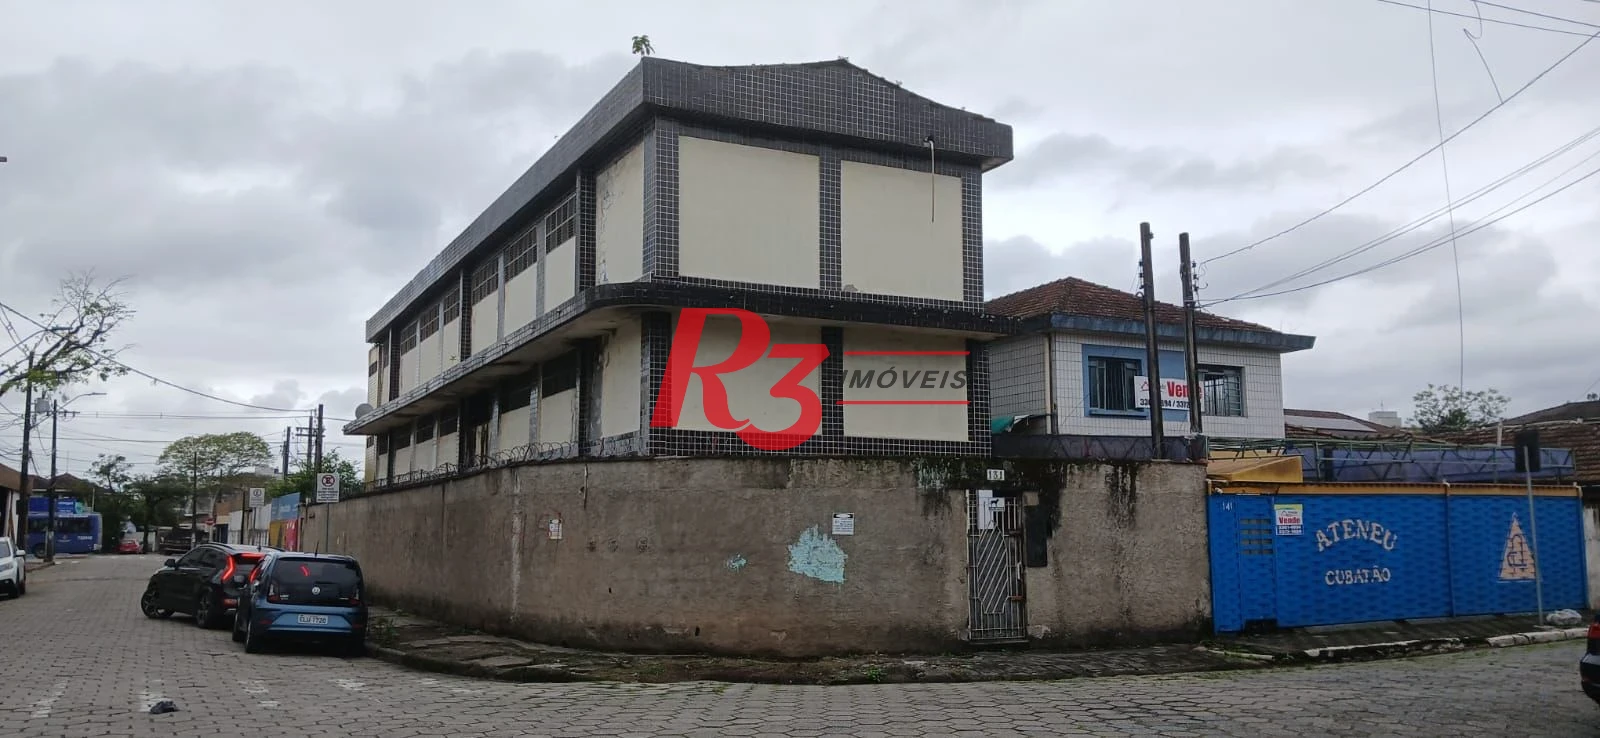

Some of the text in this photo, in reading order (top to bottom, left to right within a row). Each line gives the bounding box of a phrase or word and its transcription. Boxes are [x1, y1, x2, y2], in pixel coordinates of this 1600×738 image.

[1167, 381, 1203, 399] Vene
[988, 470, 1003, 480] 131
[1316, 519, 1397, 551] ATENEU
[1324, 565, 1391, 585] CUBATÃO
